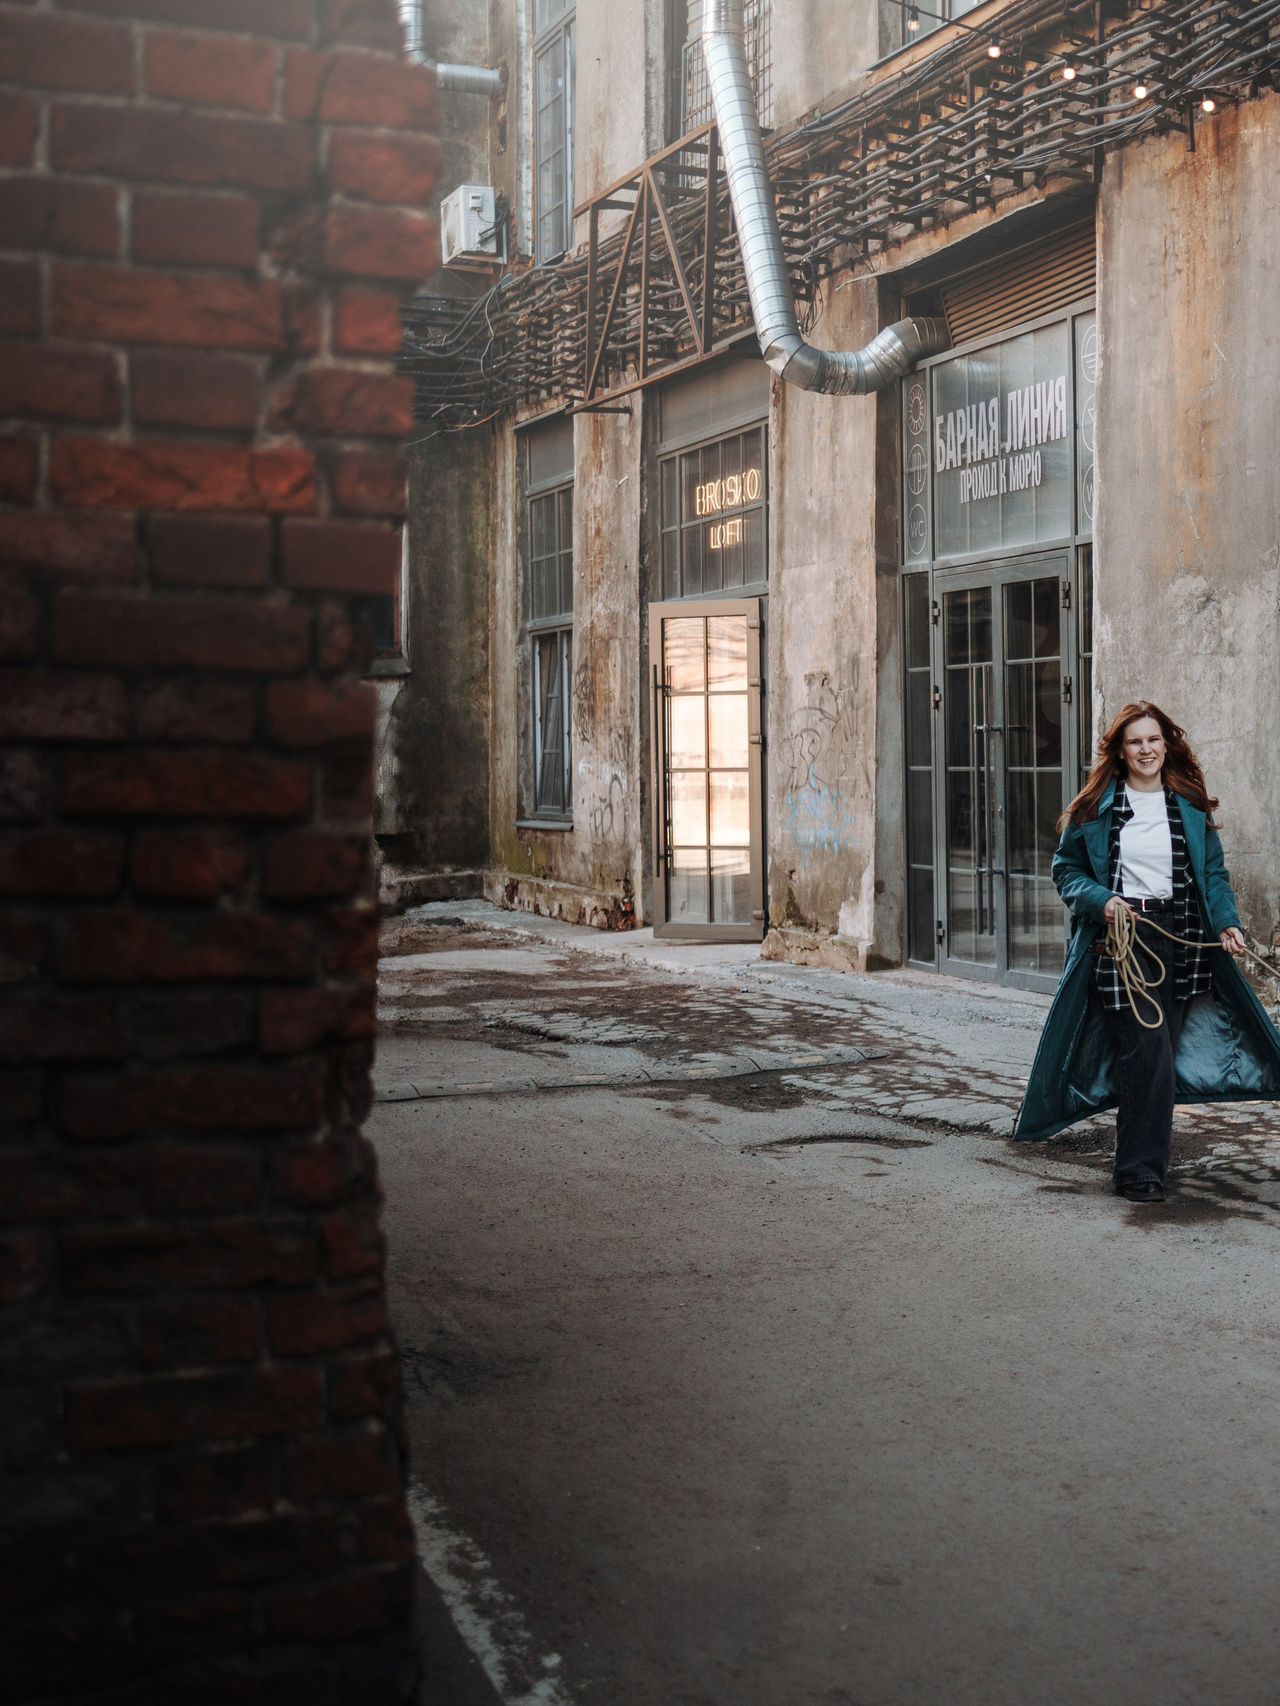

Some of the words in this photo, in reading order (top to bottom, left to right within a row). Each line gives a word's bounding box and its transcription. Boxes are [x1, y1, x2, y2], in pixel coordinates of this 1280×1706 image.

[935, 397, 999, 473] БАРНАЯ
[1005, 375, 1067, 454] ЛИНИЯ
[960, 461, 998, 504] ПРОХОД
[1000, 459, 1007, 494] К
[1009, 450, 1042, 492] МОРЮ
[710, 518, 742, 549] LOFT
[911, 520, 925, 538] WC
